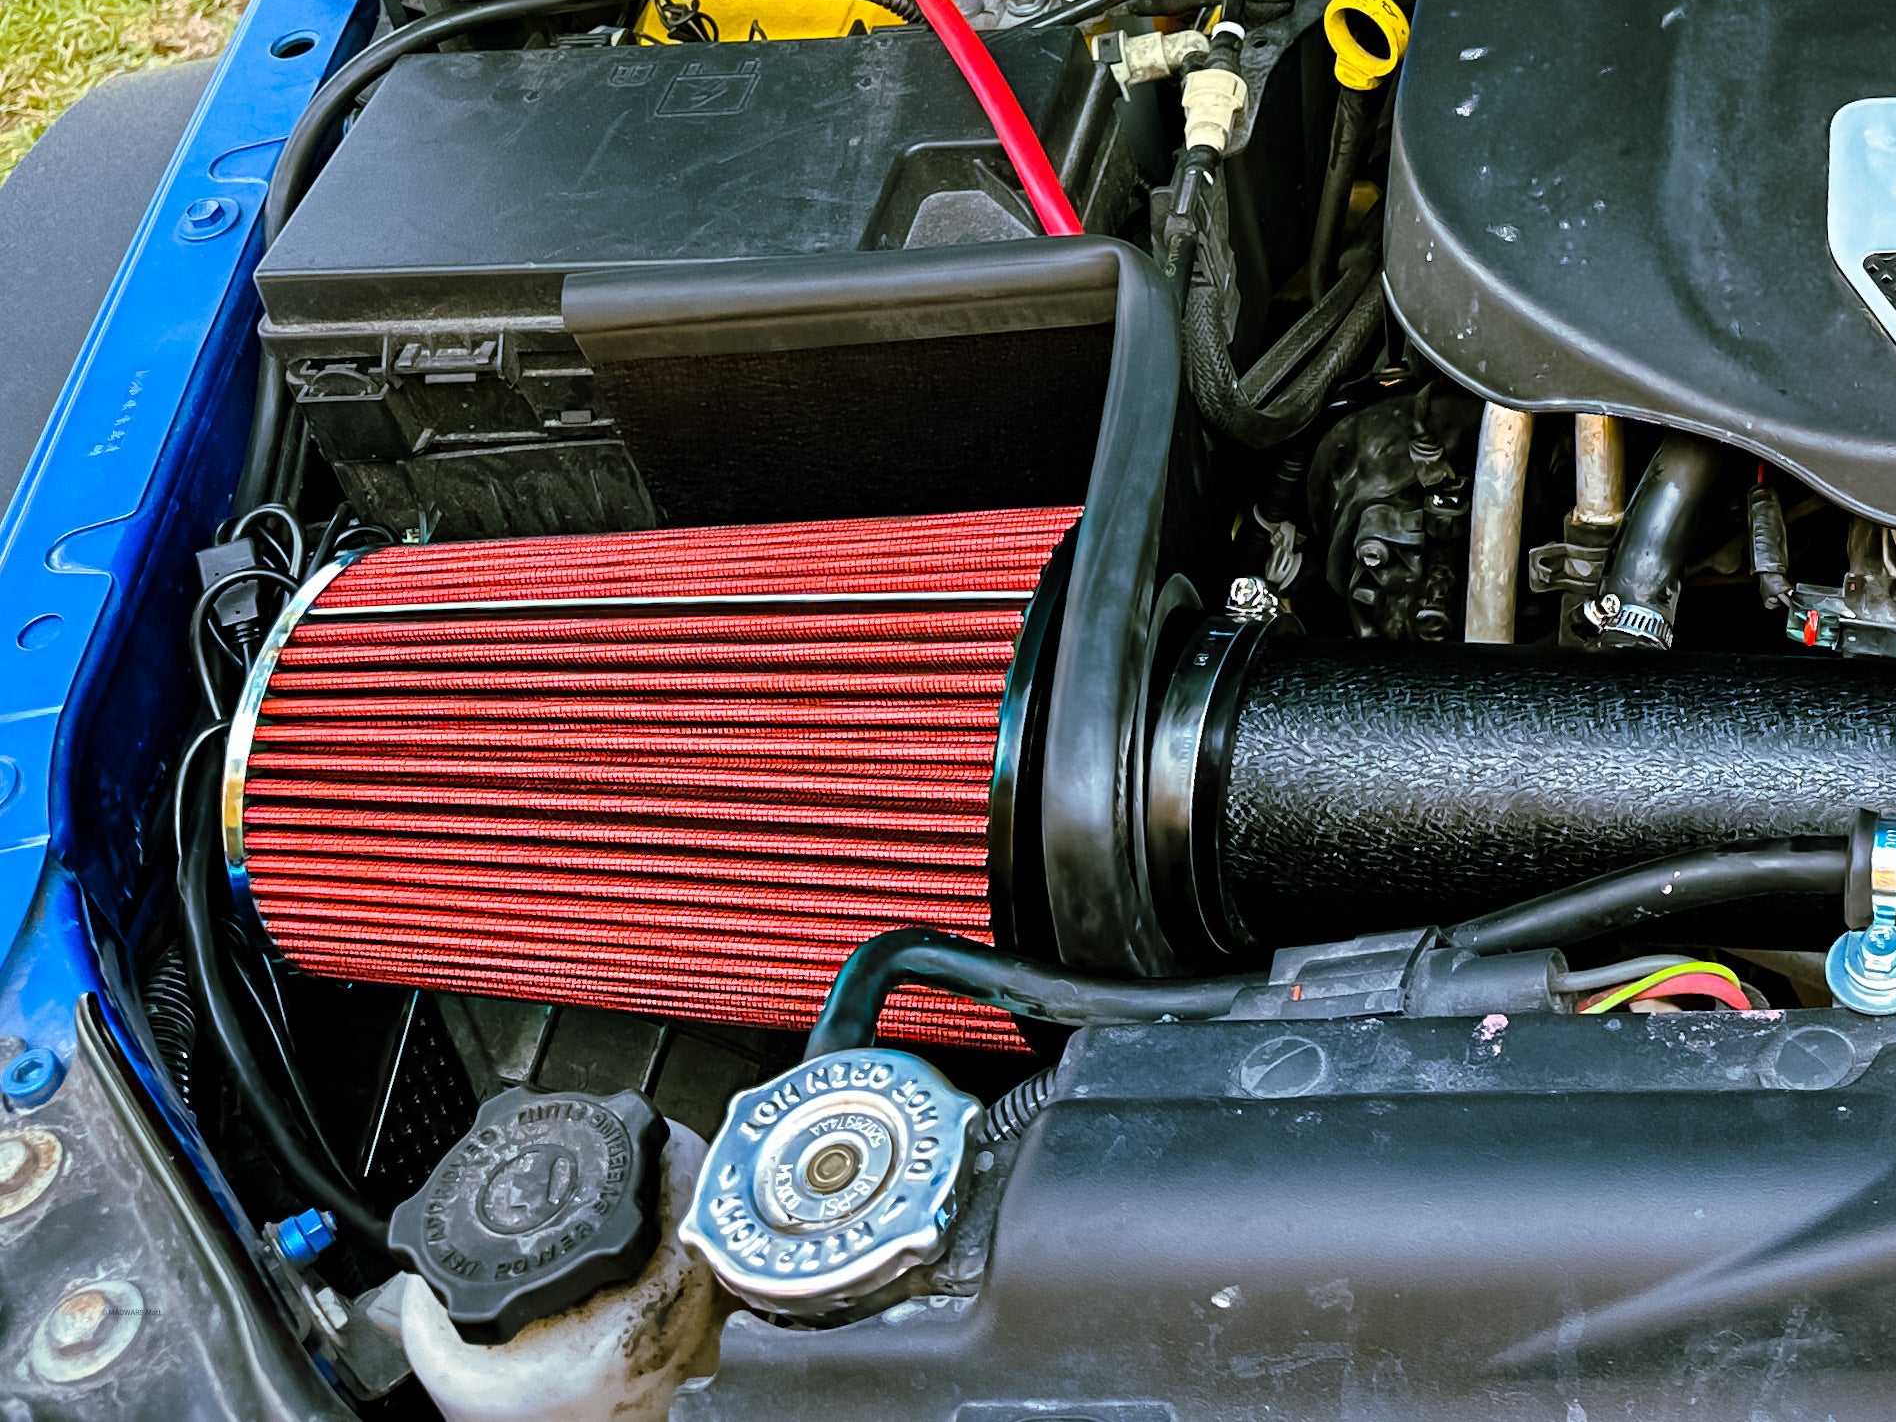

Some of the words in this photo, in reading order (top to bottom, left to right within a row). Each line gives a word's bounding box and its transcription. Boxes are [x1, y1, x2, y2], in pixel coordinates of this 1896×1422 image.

[806, 1061, 895, 1094] OPEN
[518, 1103, 587, 1125] FLUID
[740, 1080, 801, 1141] HOT
[592, 1112, 631, 1215] STEERING
[818, 1173, 878, 1218] 18-PSI
[494, 1220, 594, 1280] POWER
